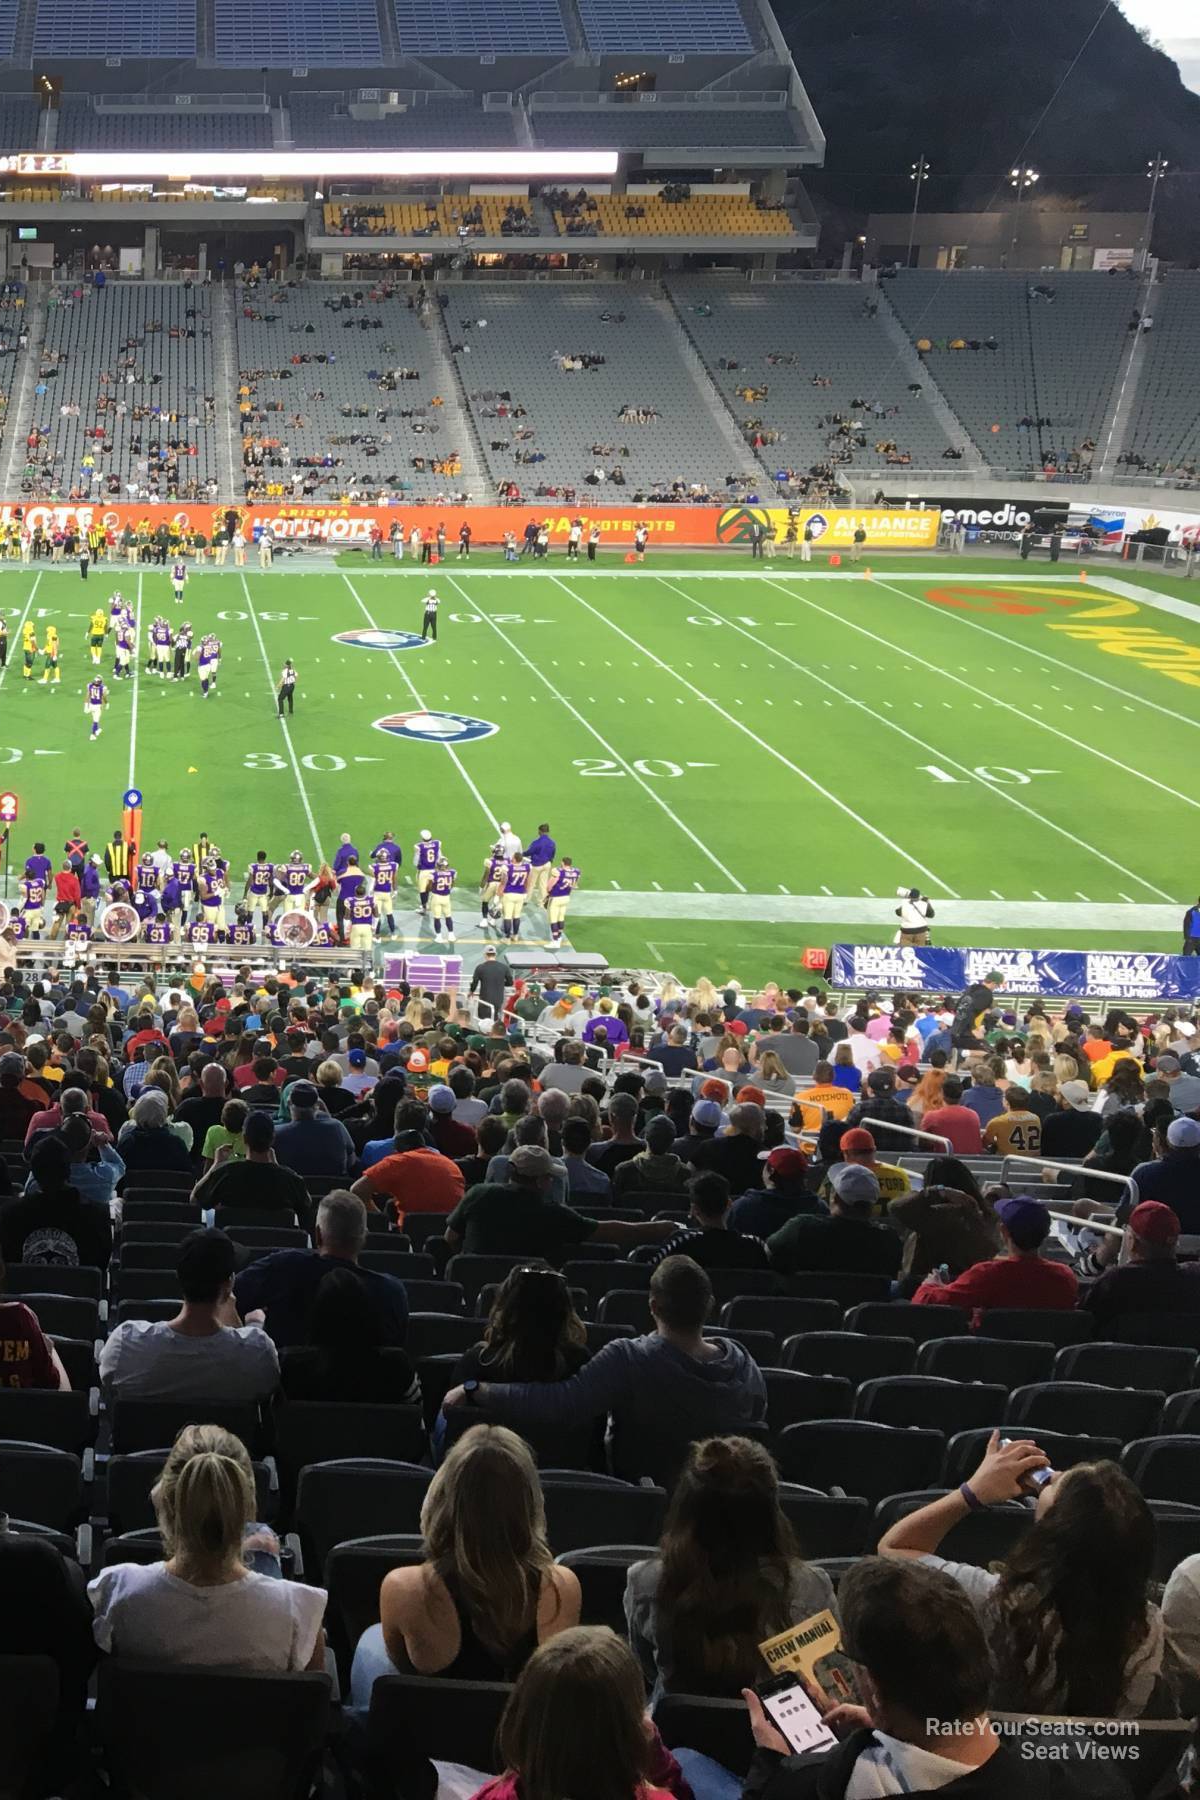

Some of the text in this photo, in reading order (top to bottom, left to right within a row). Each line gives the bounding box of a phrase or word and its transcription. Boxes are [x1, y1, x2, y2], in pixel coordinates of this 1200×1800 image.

[277, 509, 349, 517] ARIZONA
[835, 517, 932, 530] ALLIANCE
[91, 688, 100, 699] 14
[243, 752, 349, 771] 30
[571, 758, 685, 777] 20
[916, 765, 1032, 785] 10
[1, 796, 16, 814] 2
[427, 849, 435, 863] 6
[141, 874, 156, 887] 10
[289, 872, 306, 886] 80
[377, 871, 393, 884] 84
[436, 876, 452, 890] 24
[511, 871, 527, 885] 77
[353, 906, 371, 918] 90
[192, 927, 209, 940] 95
[809, 951, 825, 967] 20
[854, 946, 901, 960] NAVY
[969, 951, 1015, 965] NAVY
[855, 960, 922, 972] FEDERAL
[1087, 955, 1132, 969] NAVY
[25, 972, 39, 982] 28
[854, 974, 922, 988] Credit Union
[1087, 968, 1156, 982] FEDERAL
[1007, 982, 1039, 993] Union
[1087, 984, 1157, 998] Credit Union
[1008, 1126, 1040, 1151] 42
[766, 1640, 797, 1664] CREW
[795, 1620, 834, 1649] MANUAL
